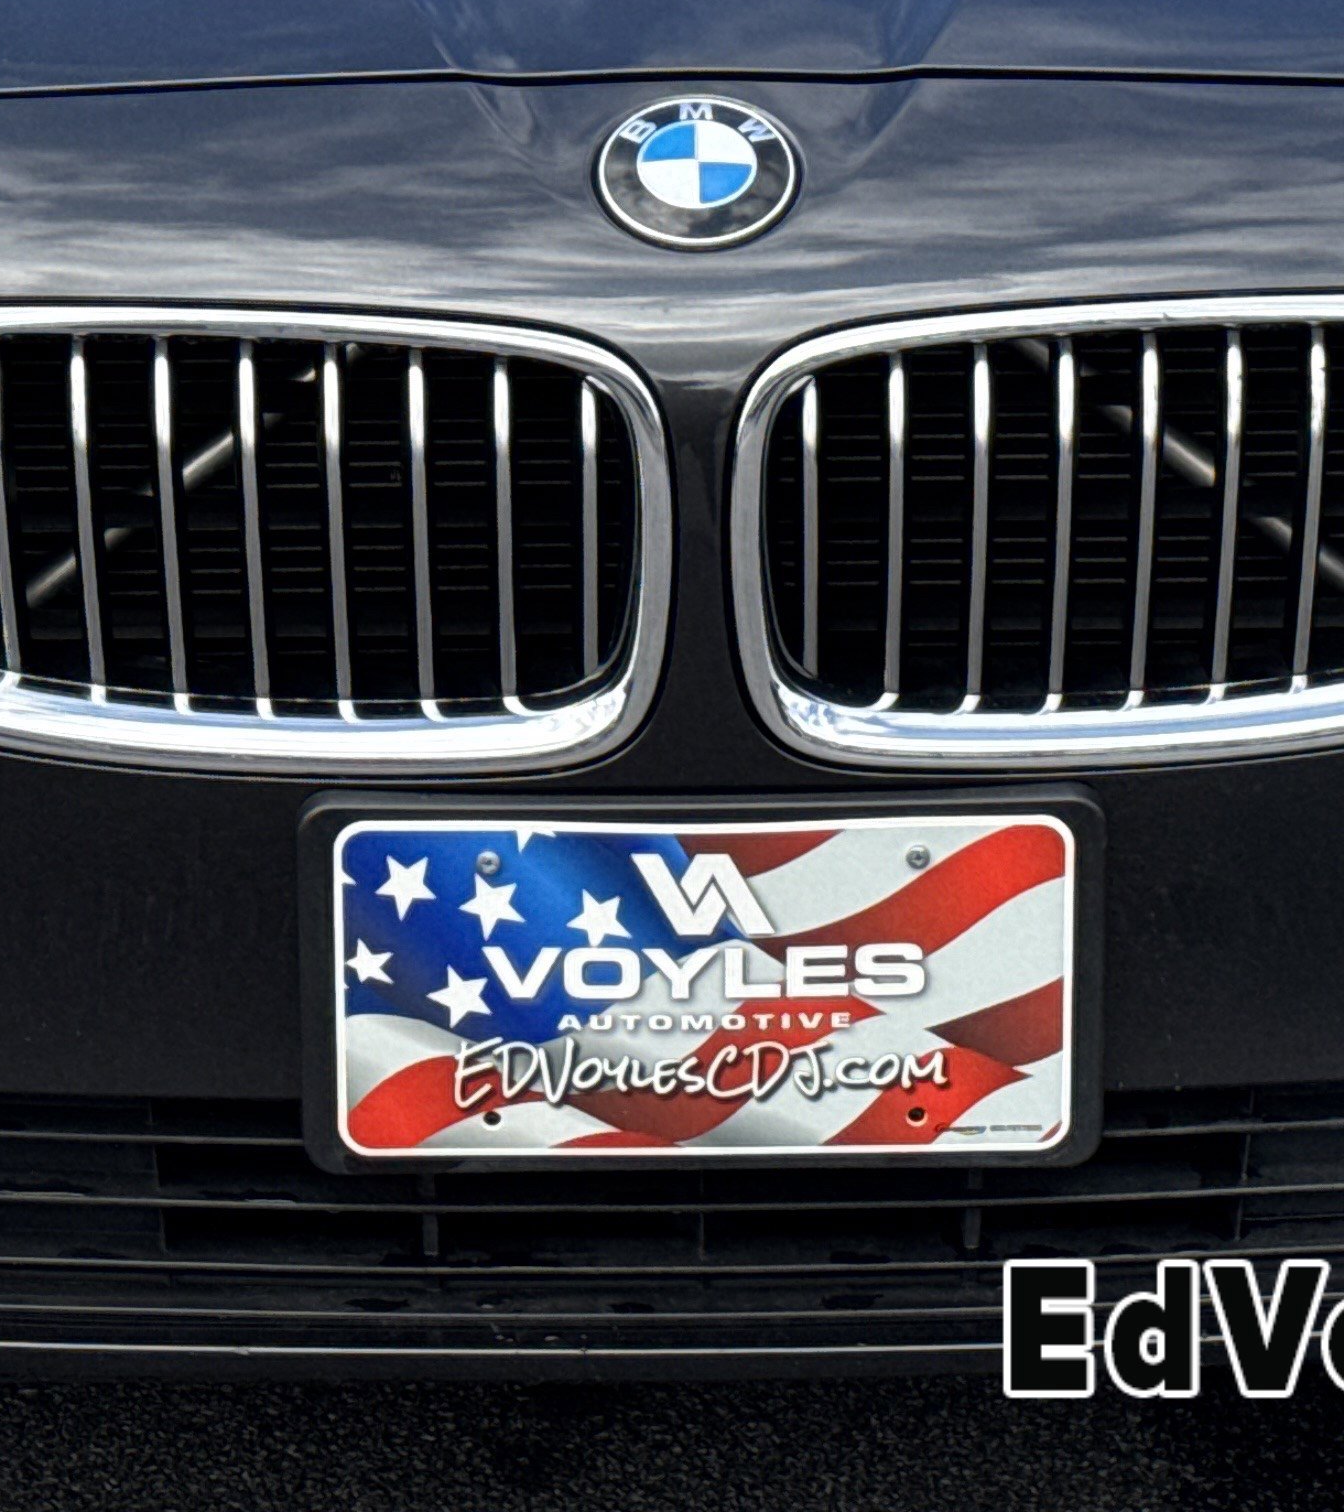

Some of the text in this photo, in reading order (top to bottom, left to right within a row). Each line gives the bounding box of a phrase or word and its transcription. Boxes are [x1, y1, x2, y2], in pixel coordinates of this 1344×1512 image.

[619, 102, 776, 143] BMW
[482, 943, 926, 999] VOYLES
[557, 1010, 853, 1030] AUTOMOTIVE
